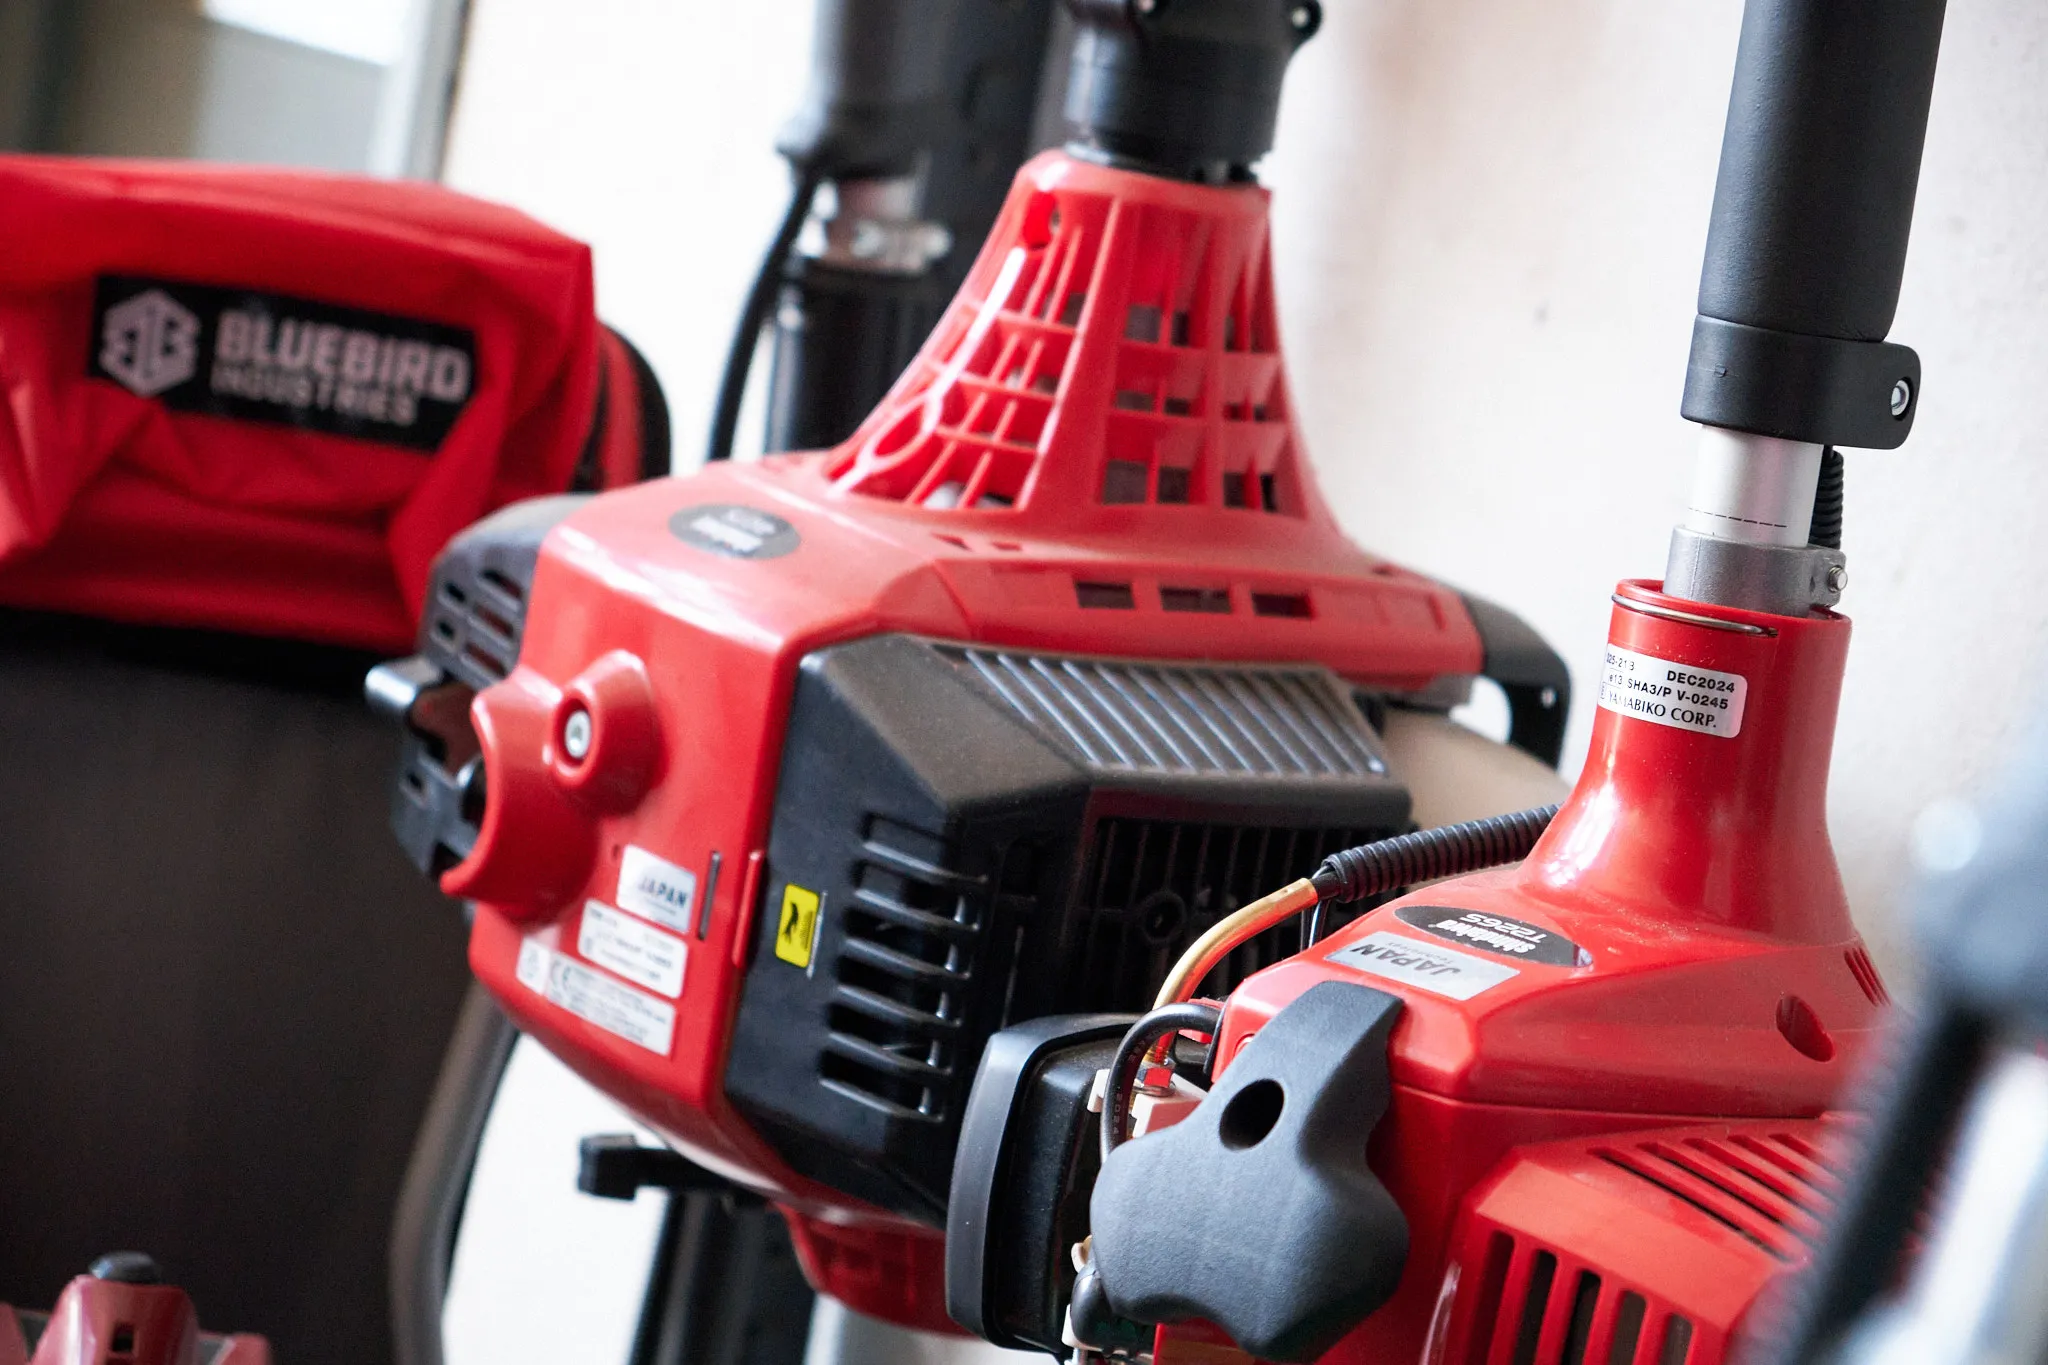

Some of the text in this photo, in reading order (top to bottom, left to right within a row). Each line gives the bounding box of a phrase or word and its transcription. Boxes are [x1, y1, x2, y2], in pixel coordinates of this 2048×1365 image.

[216, 309, 471, 403] BLUEBIRD
[210, 362, 419, 428] INDUSTRIES
[1627, 678, 1672, 698] SHA3/P
[1677, 690, 1729, 710] V-0245
[1666, 670, 1736, 693] DEC2024
[1670, 707, 1717, 728] CORP.
[637, 876, 689, 908] JAPAN
[1459, 913, 1547, 944] T226S
[1350, 943, 1461, 976] JAPAN
